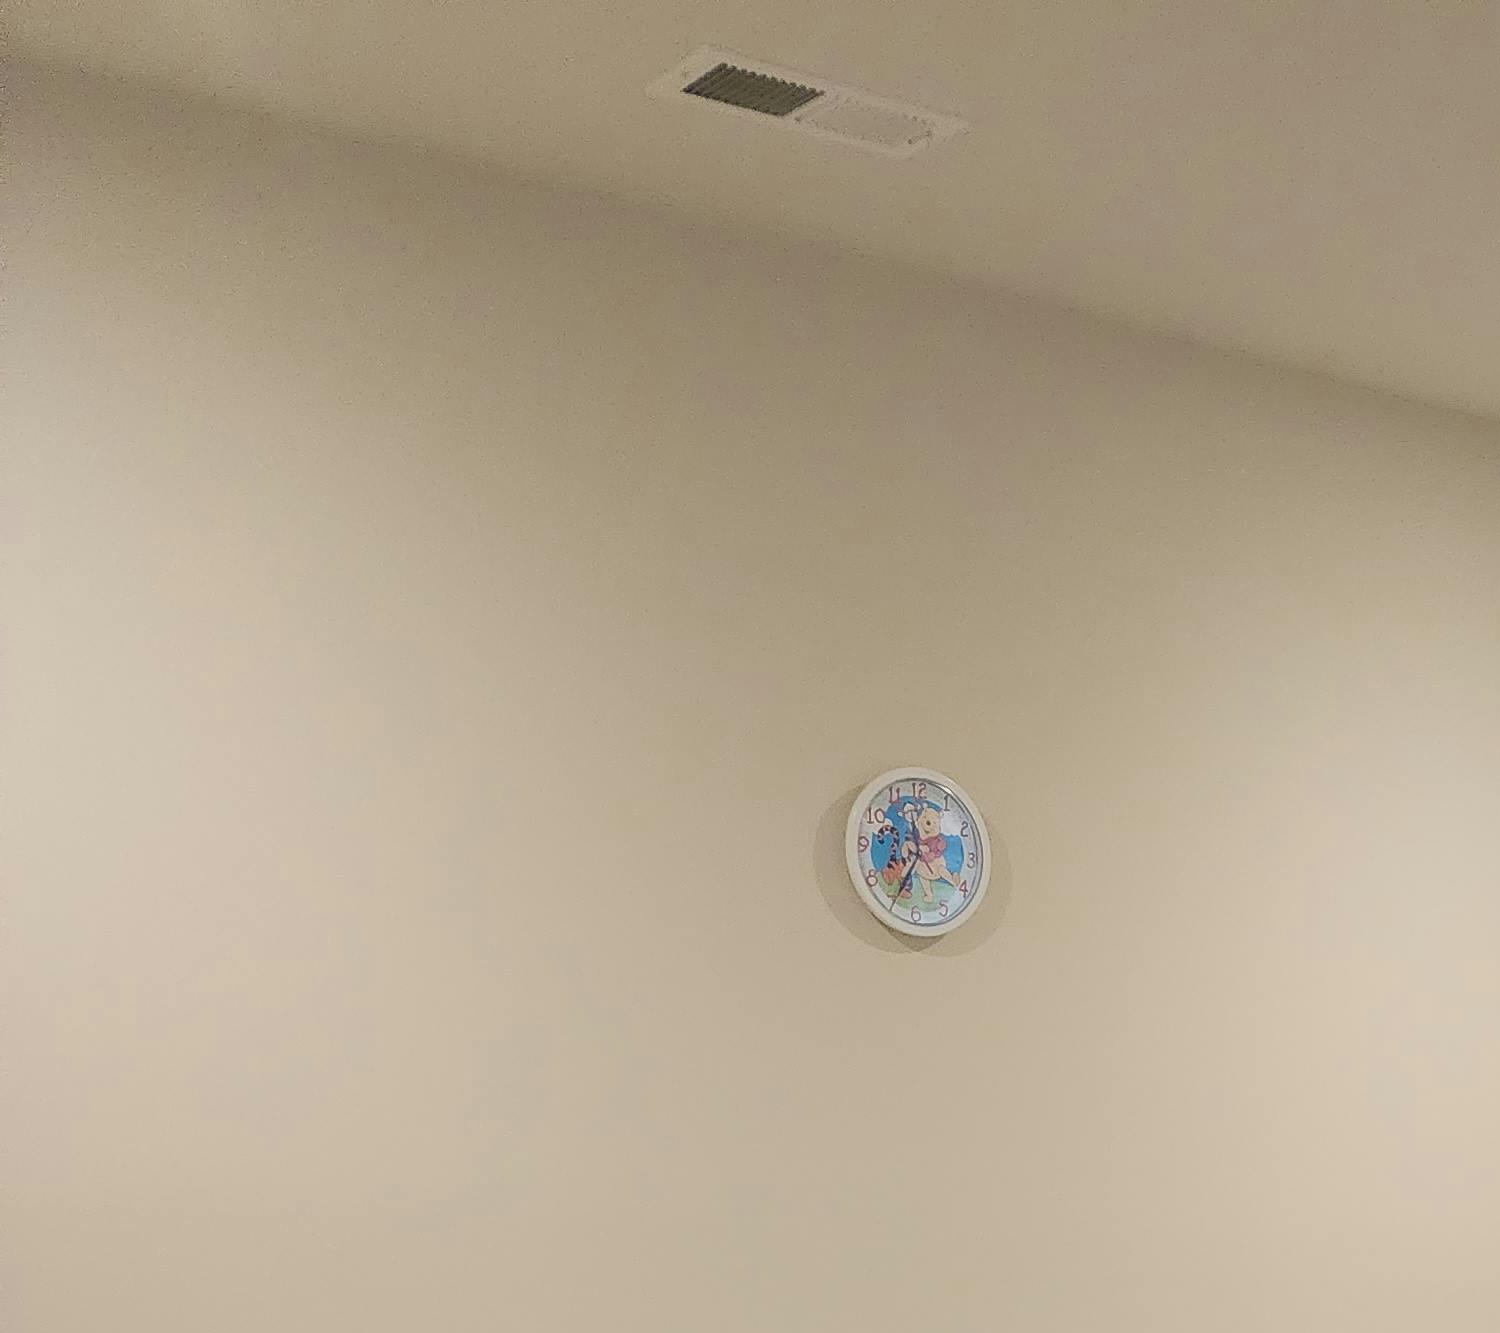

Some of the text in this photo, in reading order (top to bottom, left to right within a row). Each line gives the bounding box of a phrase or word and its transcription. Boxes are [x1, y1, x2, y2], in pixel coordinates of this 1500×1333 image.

[889, 786, 901, 804] 11
[912, 782, 927, 800] 12
[943, 795, 951, 812] 1
[866, 807, 886, 824] 10
[960, 821, 969, 837] 2
[857, 836, 869, 853] 9
[966, 852, 976, 869] 3
[866, 869, 878, 888] 8
[959, 880, 969, 899] 4
[910, 905, 921, 923] 6
[938, 900, 949, 917] 5
